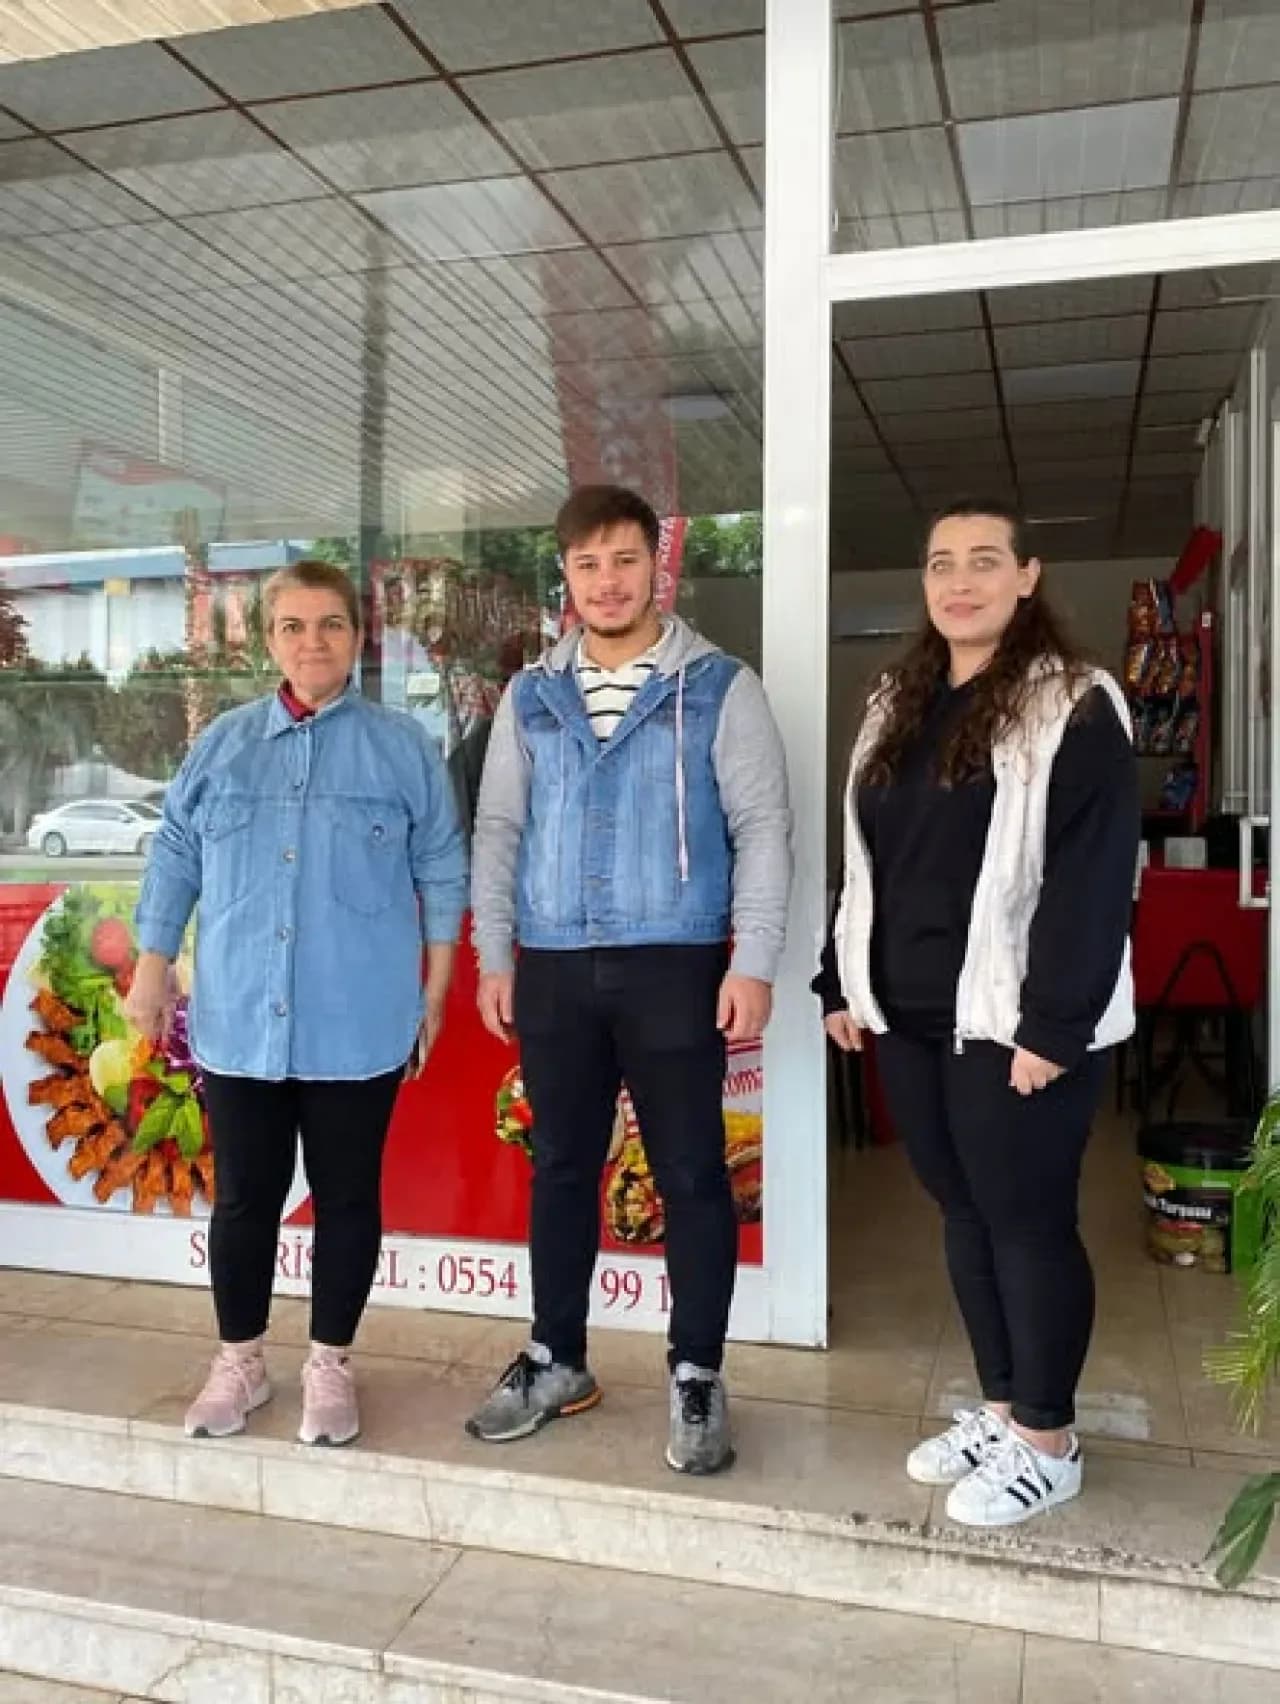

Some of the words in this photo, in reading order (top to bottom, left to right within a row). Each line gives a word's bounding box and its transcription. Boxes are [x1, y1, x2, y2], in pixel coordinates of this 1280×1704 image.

[438, 1253, 518, 1297] 0554
[600, 1267, 643, 1311] 99
[656, 1273, 669, 1312] 1
